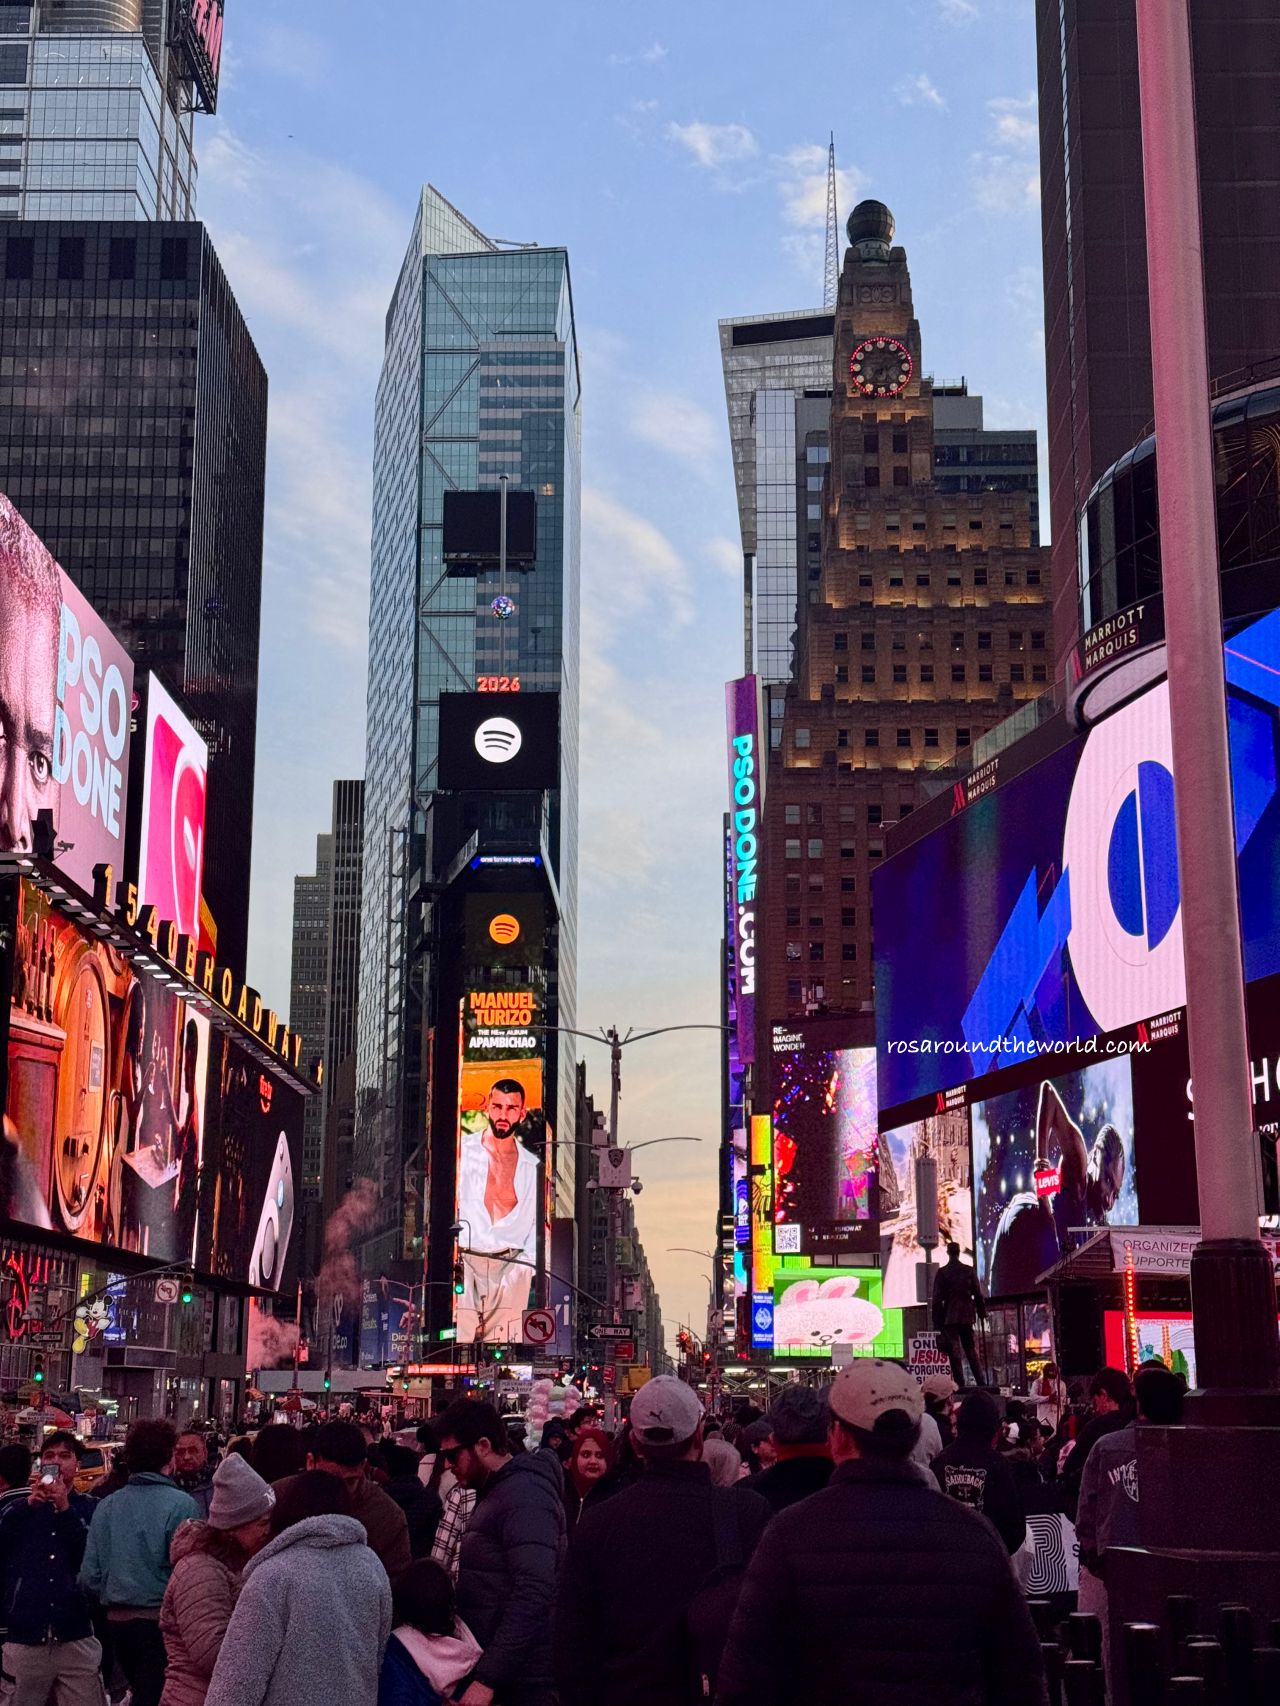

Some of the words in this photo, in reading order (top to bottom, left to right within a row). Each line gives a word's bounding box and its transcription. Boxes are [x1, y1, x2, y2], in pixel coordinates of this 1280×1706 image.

[1085, 605, 1145, 651] MARRIOTT
[1085, 629, 1137, 670] MARQUIS
[57, 602, 126, 761] PSO
[477, 676, 521, 692] 2026
[52, 704, 122, 840] DONE
[967, 758, 999, 788] MARRIOTT
[967, 775, 996, 801] MARQUIS
[105, 863, 178, 956] 1540
[185, 937, 303, 1068] BROADWAY
[470, 992, 537, 1009] MANUEL
[474, 1009, 532, 1026] TURIZO
[1150, 1011, 1181, 1029] MARRIOTT
[1151, 1024, 1179, 1041] MARQUIS
[469, 1036, 537, 1049] APAMBICHAO
[1122, 1255, 1190, 1268] SUPPORTE
[912, 1340, 938, 1350] ONL
[911, 1349, 948, 1364] JESUS
[909, 1364, 951, 1376] FORGIVES
